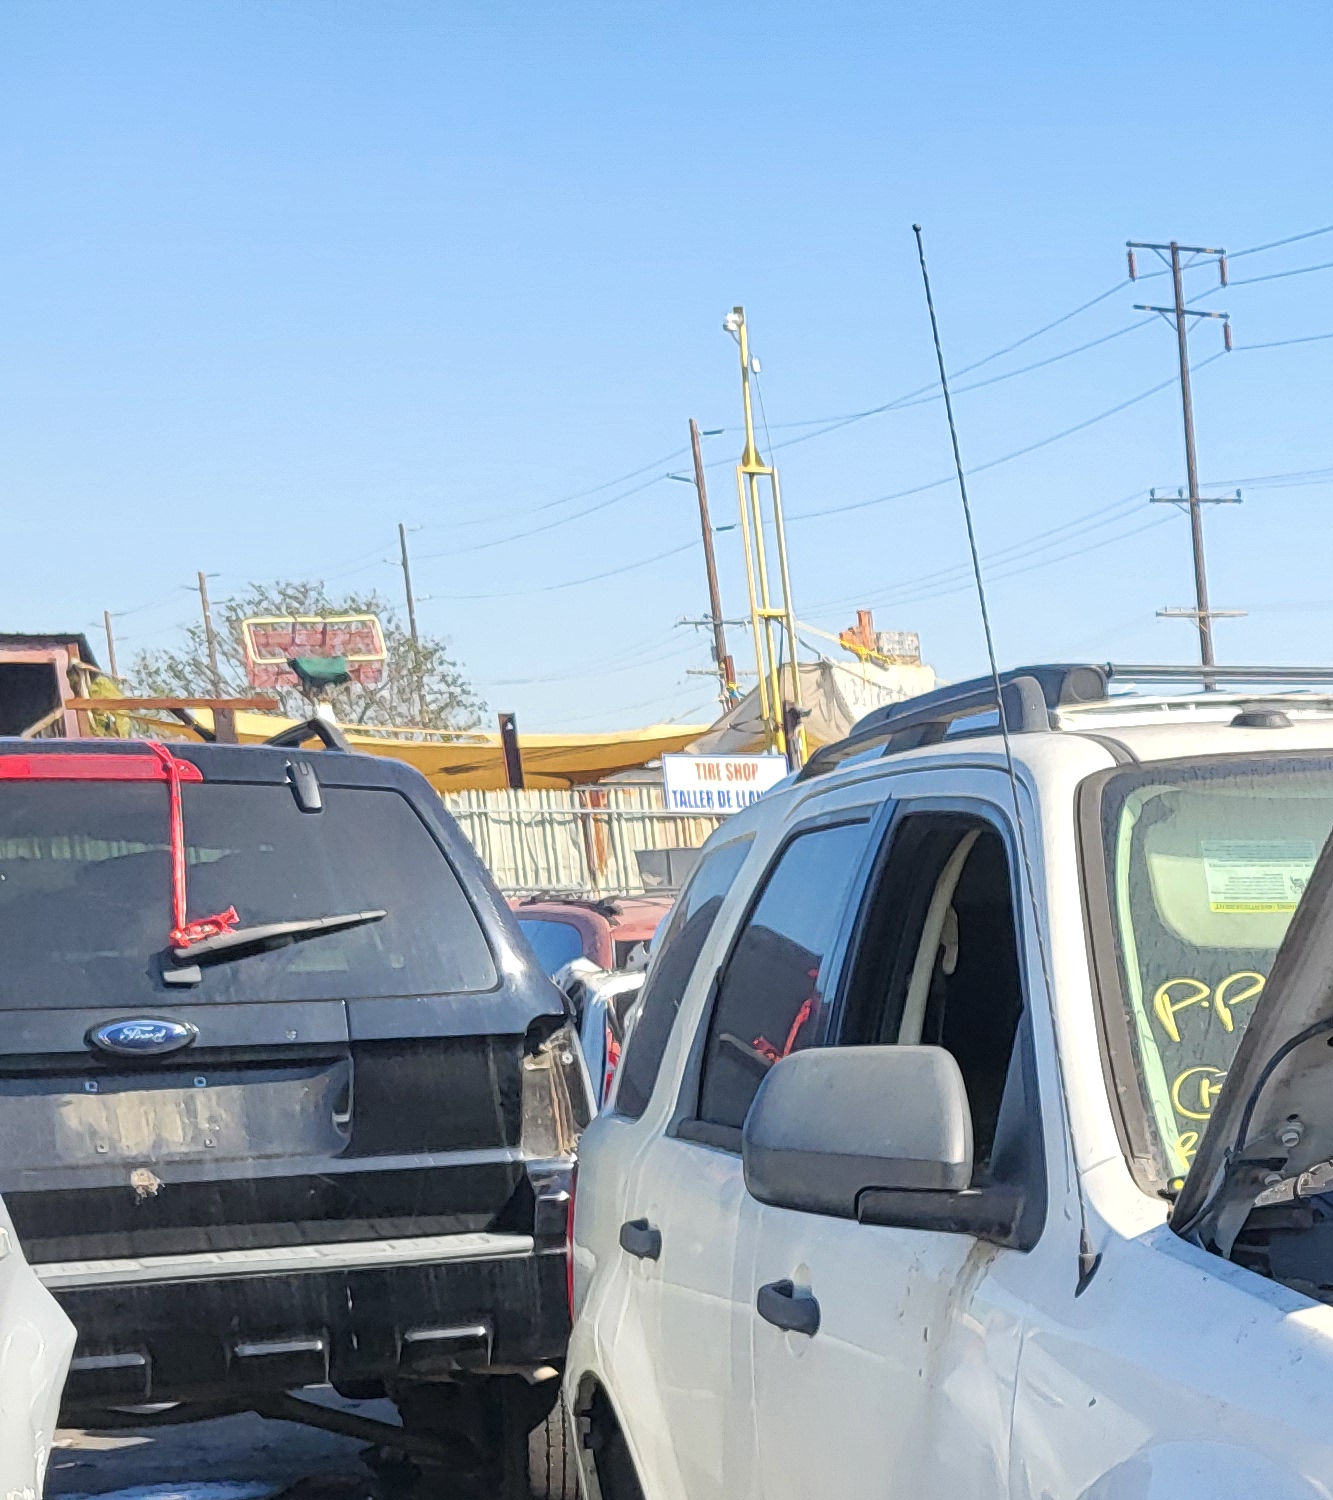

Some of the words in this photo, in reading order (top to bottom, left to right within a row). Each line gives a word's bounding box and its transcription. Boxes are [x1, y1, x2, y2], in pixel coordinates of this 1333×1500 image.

[694, 762, 722, 781] TIRE
[725, 762, 759, 782] SHOP
[672, 789, 715, 810] TALLER
[717, 789, 733, 809] DE
[736, 789, 767, 809] LLAN
[119, 1025, 167, 1043] Ford
